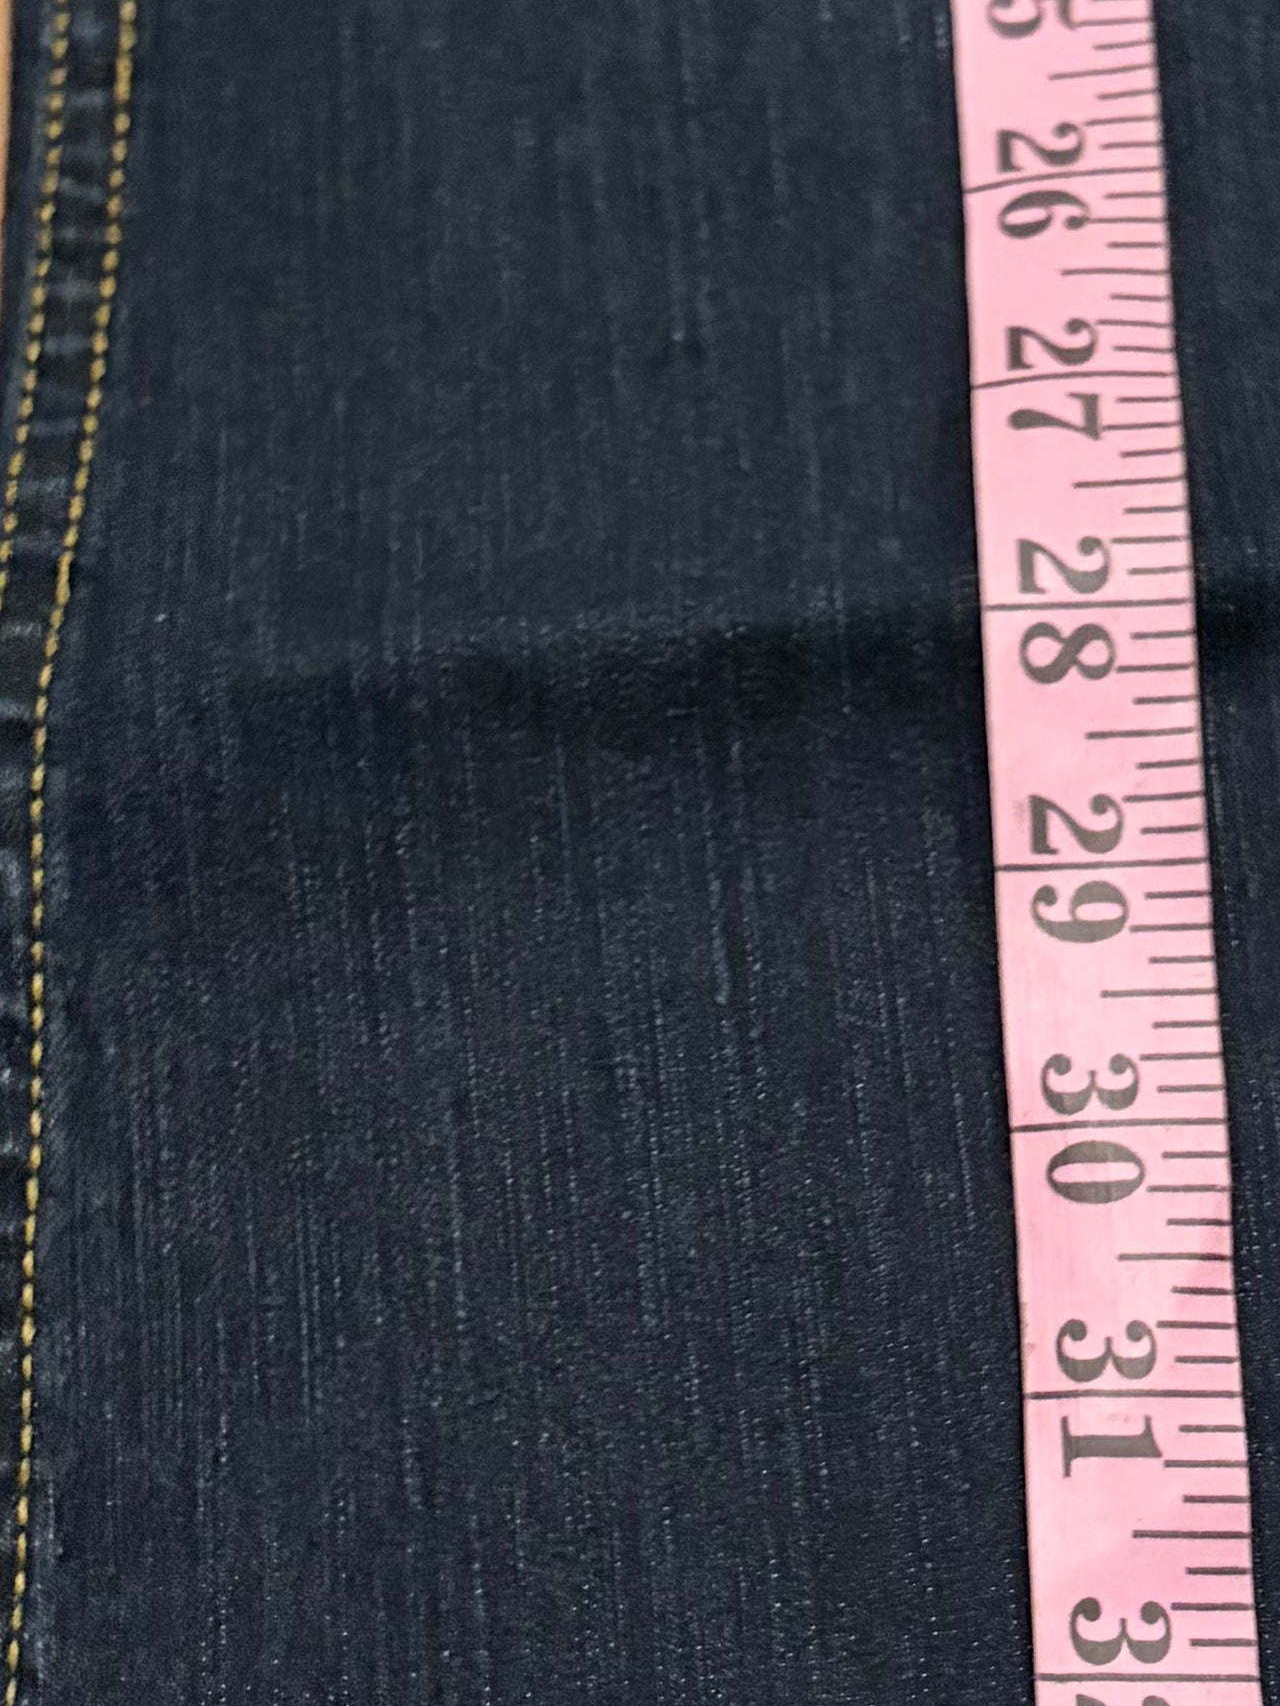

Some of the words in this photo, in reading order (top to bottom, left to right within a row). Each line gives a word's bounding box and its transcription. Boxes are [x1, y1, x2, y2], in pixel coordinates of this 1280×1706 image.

[996, 122, 1092, 239] 26
[1005, 318, 1103, 440] 27
[1015, 535, 1116, 684] 28
[1029, 792, 1129, 943] 29
[1041, 1053, 1145, 1204] 30
[1056, 1318, 1162, 1478] 31
